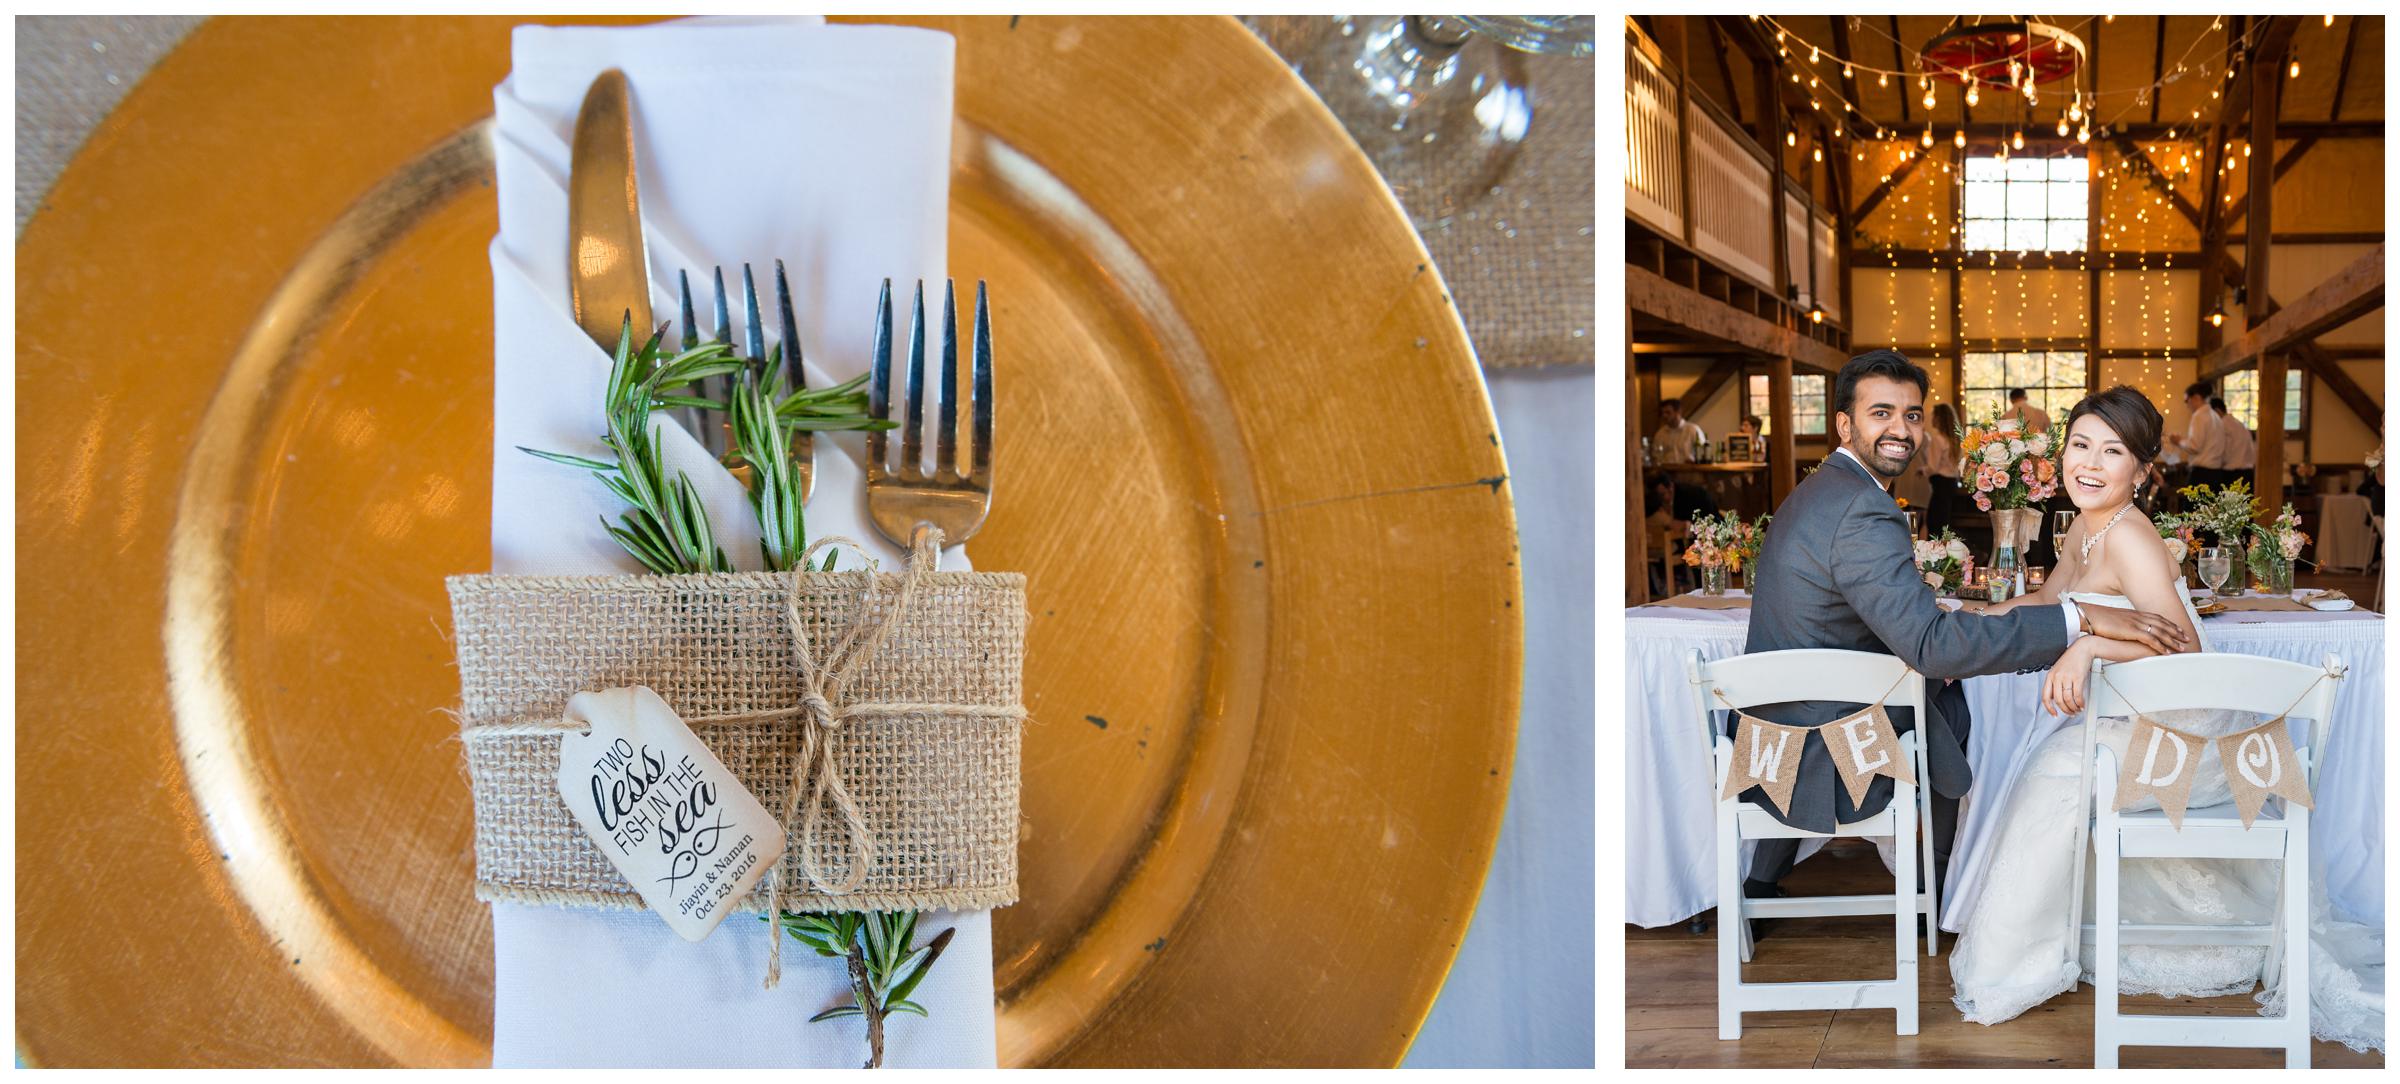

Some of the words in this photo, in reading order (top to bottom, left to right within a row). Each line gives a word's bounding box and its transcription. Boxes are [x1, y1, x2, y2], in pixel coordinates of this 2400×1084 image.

[594, 738, 634, 780] TWO
[1748, 713, 1889, 784] WE
[2135, 726, 2282, 789] DO
[591, 744, 666, 831] less
[613, 808, 655, 856] FISH
[646, 789, 672, 818] IN
[663, 755, 703, 797] THE
[658, 780, 717, 854] sea
[679, 883, 709, 915] Jiayin
[705, 872, 718, 884] &
[714, 834, 754, 876] Naman
[695, 900, 718, 920] Oct.
[715, 881, 735, 898] 23,
[733, 853, 758, 881] 2016
